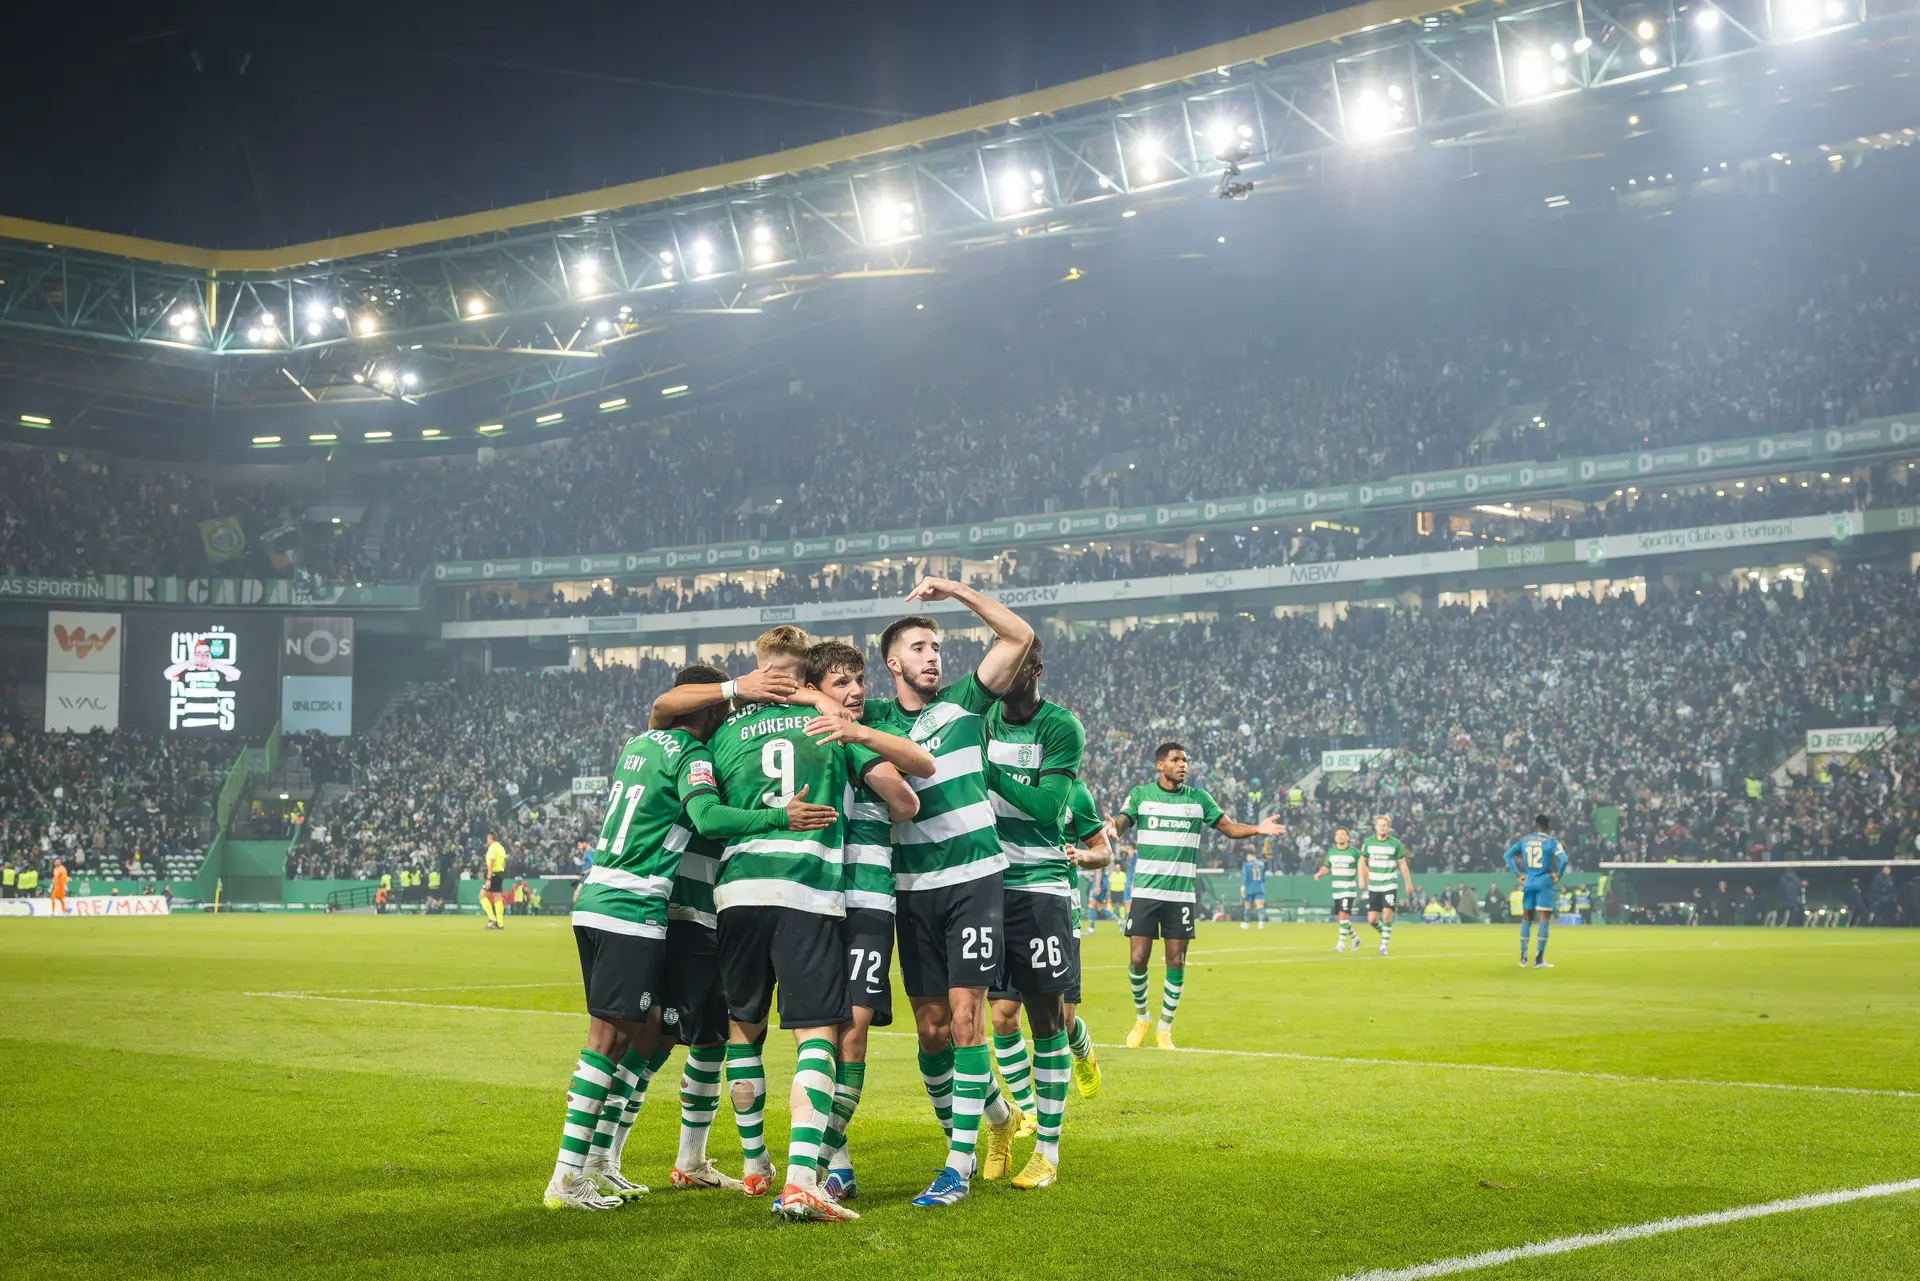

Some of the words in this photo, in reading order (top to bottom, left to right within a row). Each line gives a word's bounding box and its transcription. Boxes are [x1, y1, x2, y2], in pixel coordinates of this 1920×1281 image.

[1638, 533, 1685, 550] Sporting
[1688, 528, 1720, 543] Clube
[1725, 528, 1739, 540] de
[1743, 520, 1794, 540] Portugal
[1290, 564, 1340, 582] MBW
[104, 574, 288, 604] BRIGADA
[286, 630, 352, 664] NOS
[740, 716, 811, 740] GYÖKERES
[649, 730, 682, 758] BOCK
[624, 755, 646, 772] GENY
[762, 739, 794, 808] 9
[596, 780, 646, 855] 21
[1159, 819, 1191, 830] BETANO
[1526, 846, 1543, 869] 12
[76, 900, 162, 916] RE/MAX
[1182, 906, 1190, 924] 2
[962, 926, 993, 959] 25
[1030, 936, 1062, 968] 26
[850, 948, 882, 984] 72
